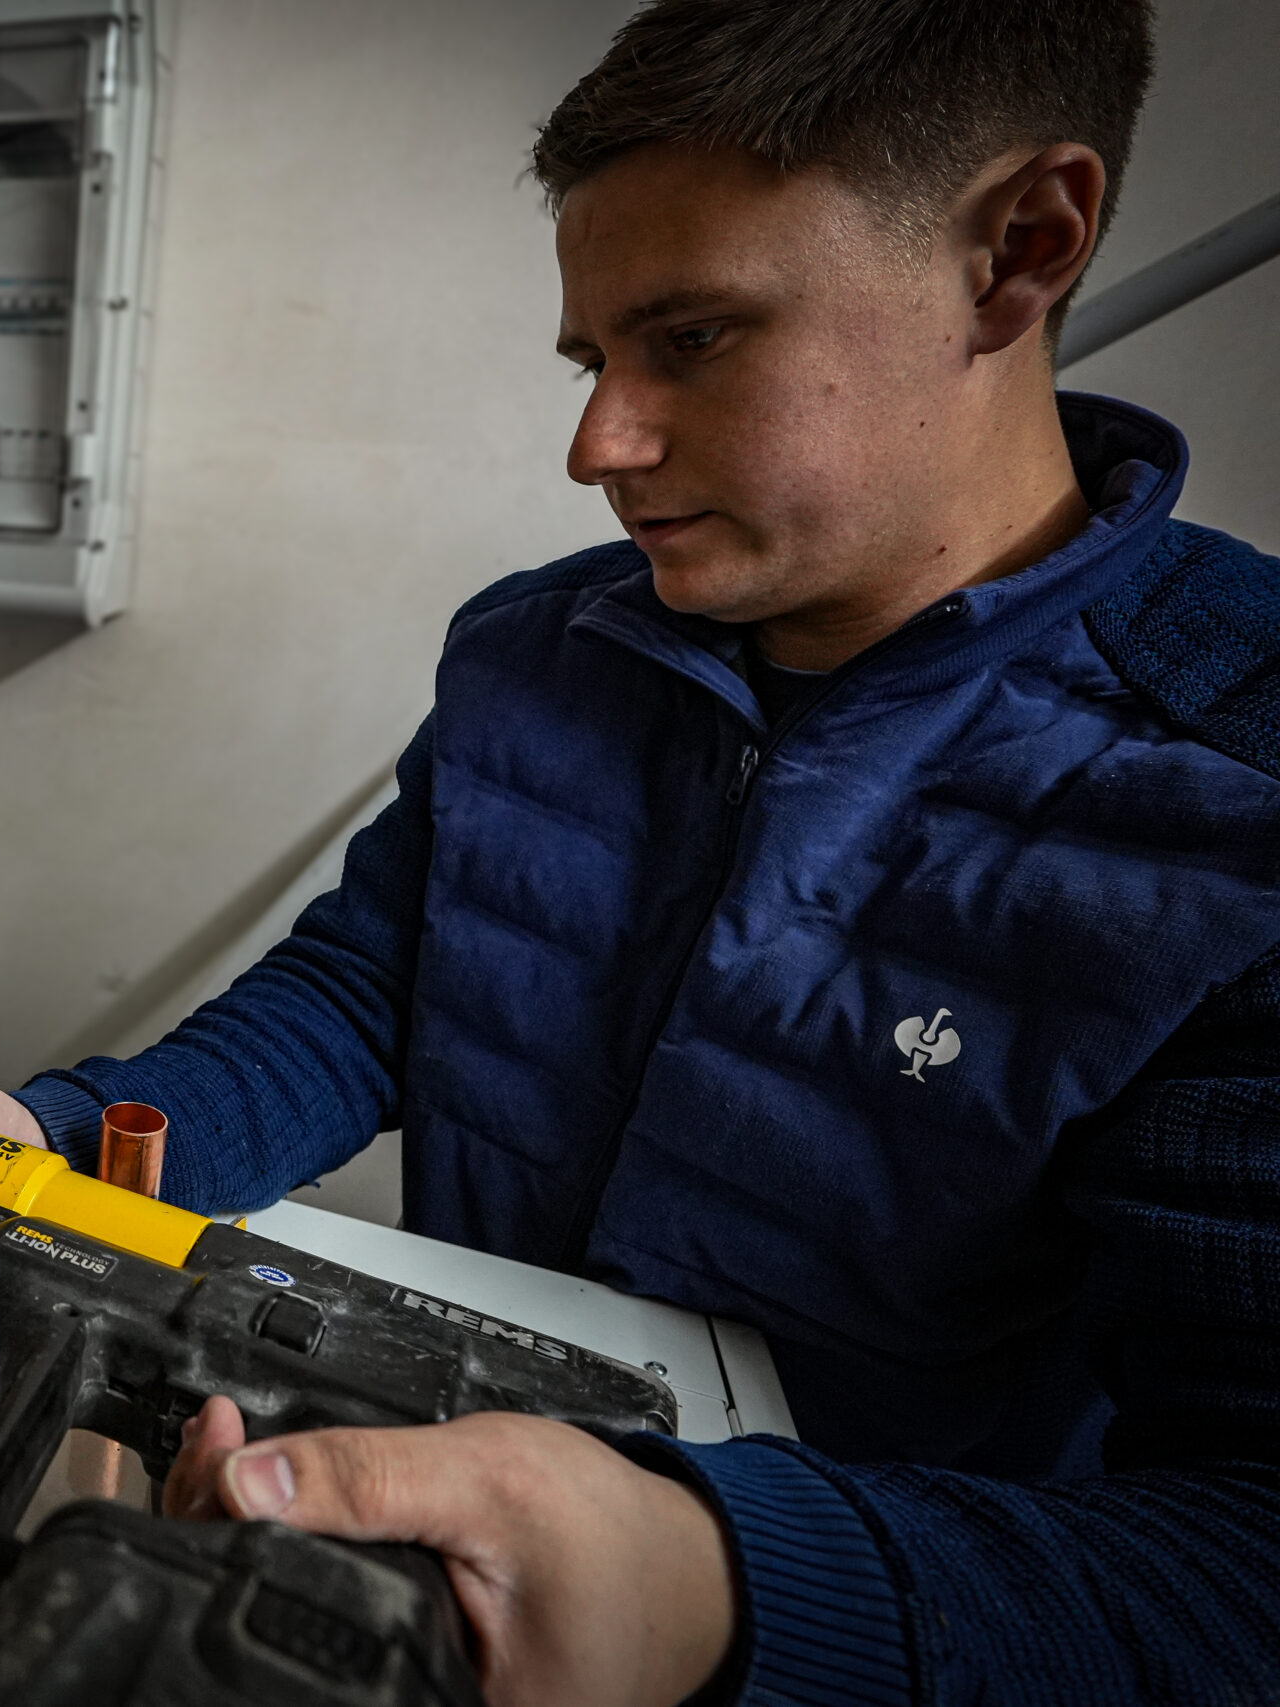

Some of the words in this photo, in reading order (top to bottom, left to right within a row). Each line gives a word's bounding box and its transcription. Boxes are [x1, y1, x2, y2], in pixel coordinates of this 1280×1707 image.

[16, 1225, 54, 1244] REMS
[55, 1241, 110, 1266] TECHNOLOGY
[59, 1250, 107, 1274] PLUS
[402, 1291, 569, 1361] REMS
